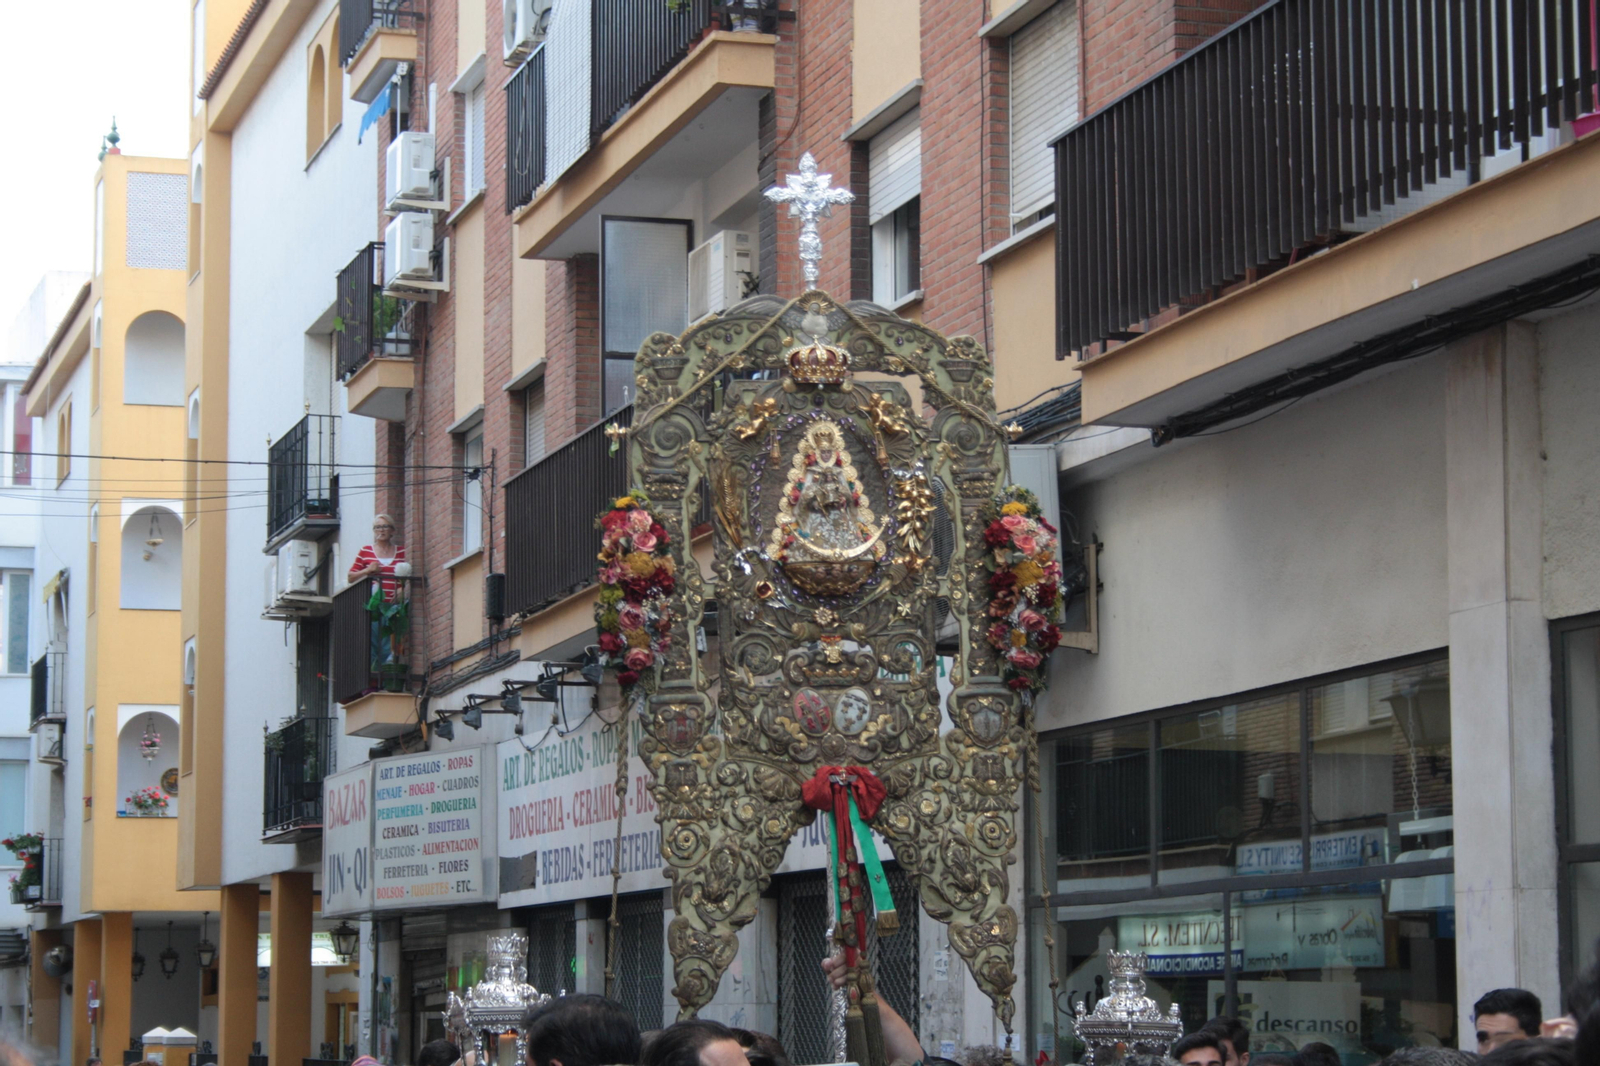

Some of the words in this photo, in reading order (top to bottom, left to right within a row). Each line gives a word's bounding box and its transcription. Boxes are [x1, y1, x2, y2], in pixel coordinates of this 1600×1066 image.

[379, 768, 394, 781] ART.
[396, 765, 406, 778] DE
[407, 760, 441, 777] REGALOS
[447, 755, 474, 771] ROPAS
[503, 755, 522, 791] ART.
[524, 750, 536, 787] DE
[538, 736, 584, 783] REGALOS
[376, 786, 403, 800] MENAJE
[408, 781, 435, 797] HOGAR
[442, 775, 479, 792] CUADROS
[328, 779, 367, 831] BAZAR
[377, 804, 424, 821] PERFUMERIA
[430, 797, 477, 814] DROGUERIA
[382, 824, 419, 840] CERAMICA
[427, 818, 471, 834] BISUTERIA
[509, 795, 565, 841] DROGUERIA
[374, 845, 416, 861] PLASTICOS
[421, 837, 480, 856] ALIMENTACION
[383, 864, 429, 879] FERRETERIA
[438, 859, 469, 874] FLORES
[542, 843, 585, 886] BEBIDAS
[326, 852, 345, 905] JIN
[376, 886, 405, 900] BOLSOS
[410, 882, 450, 898] JUGUETES
[1256, 1011, 1358, 1034] descanso
